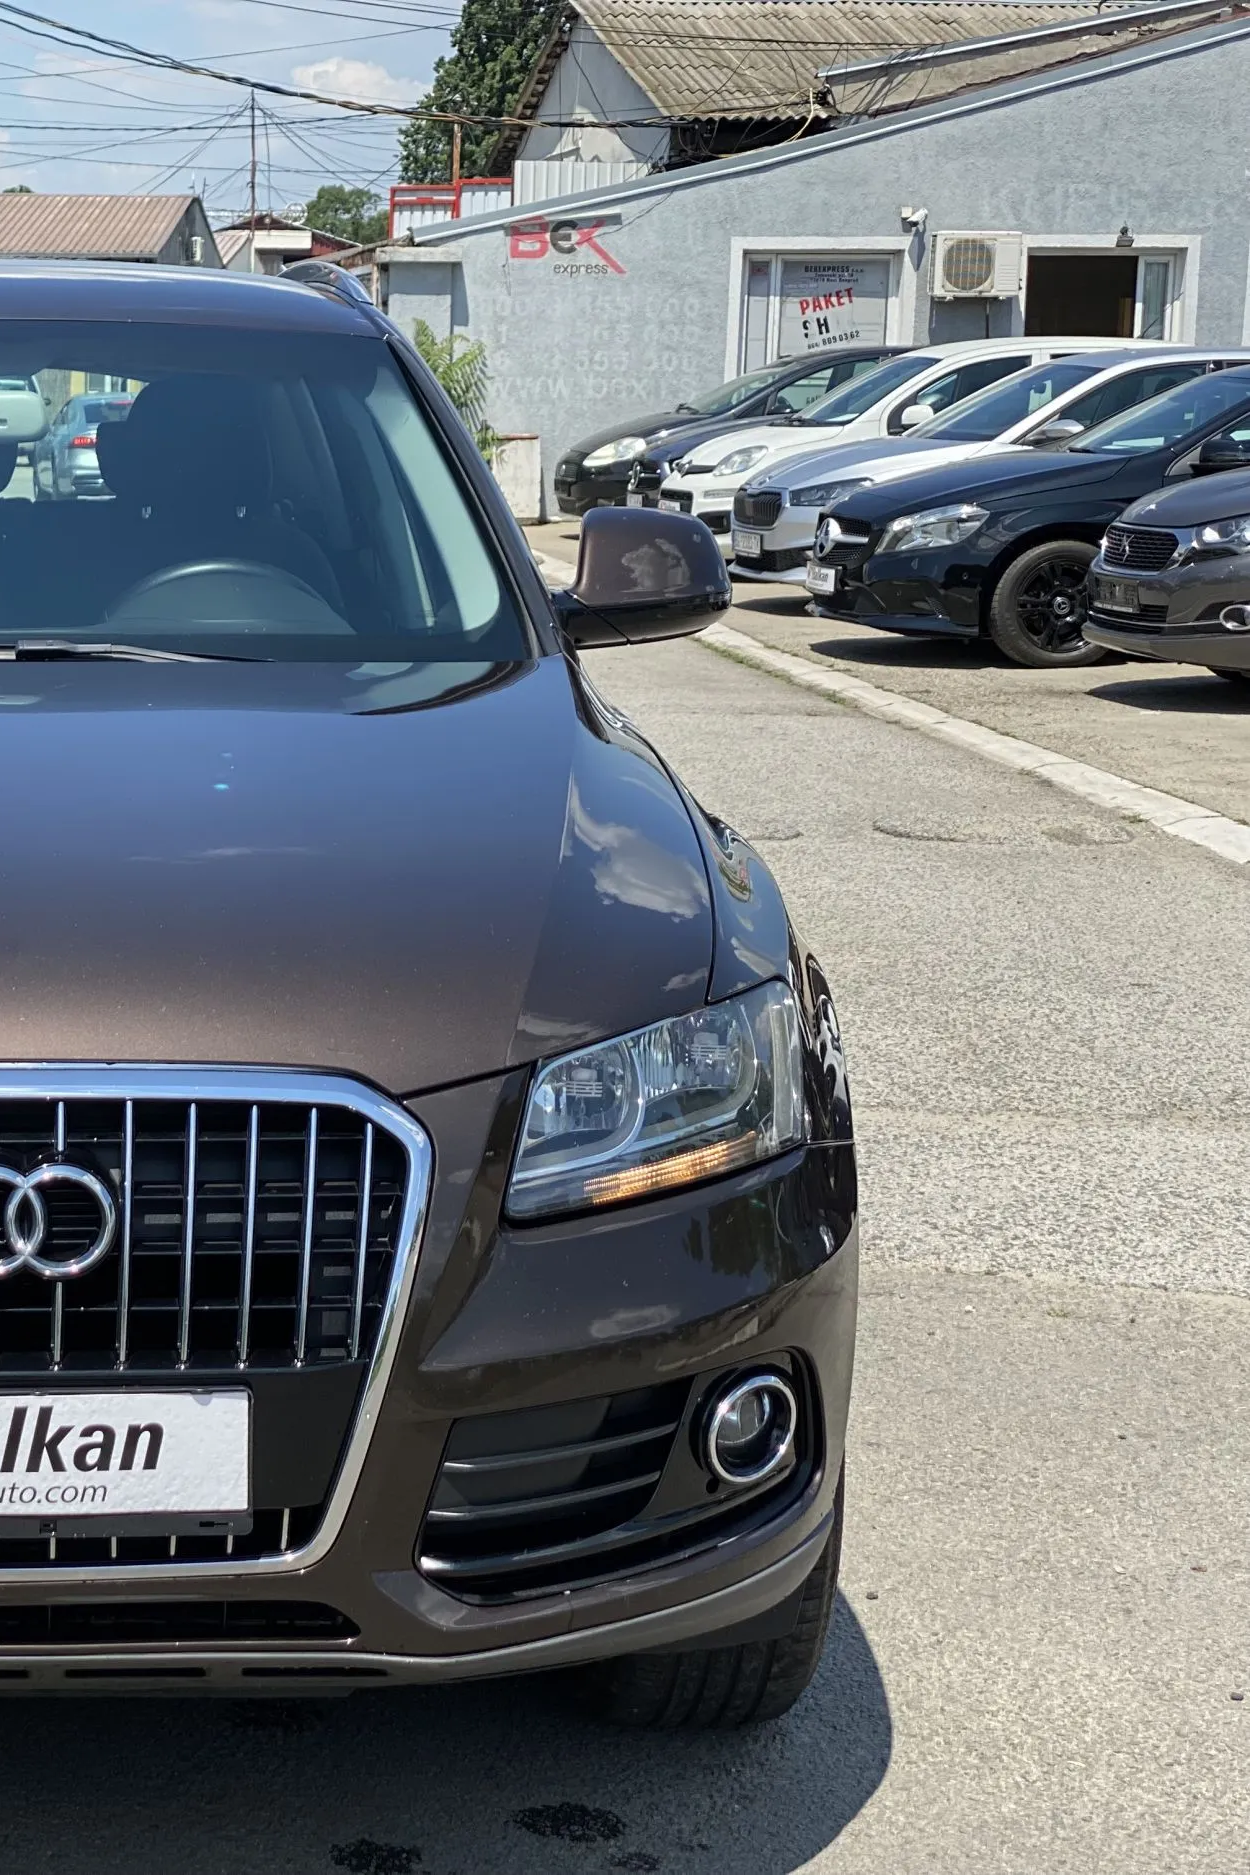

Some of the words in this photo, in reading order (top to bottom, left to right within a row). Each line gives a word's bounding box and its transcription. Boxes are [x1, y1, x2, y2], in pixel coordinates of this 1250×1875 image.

[510, 215, 627, 274] BEX
[553, 263, 610, 278] express
[799, 287, 853, 315] PAKET
